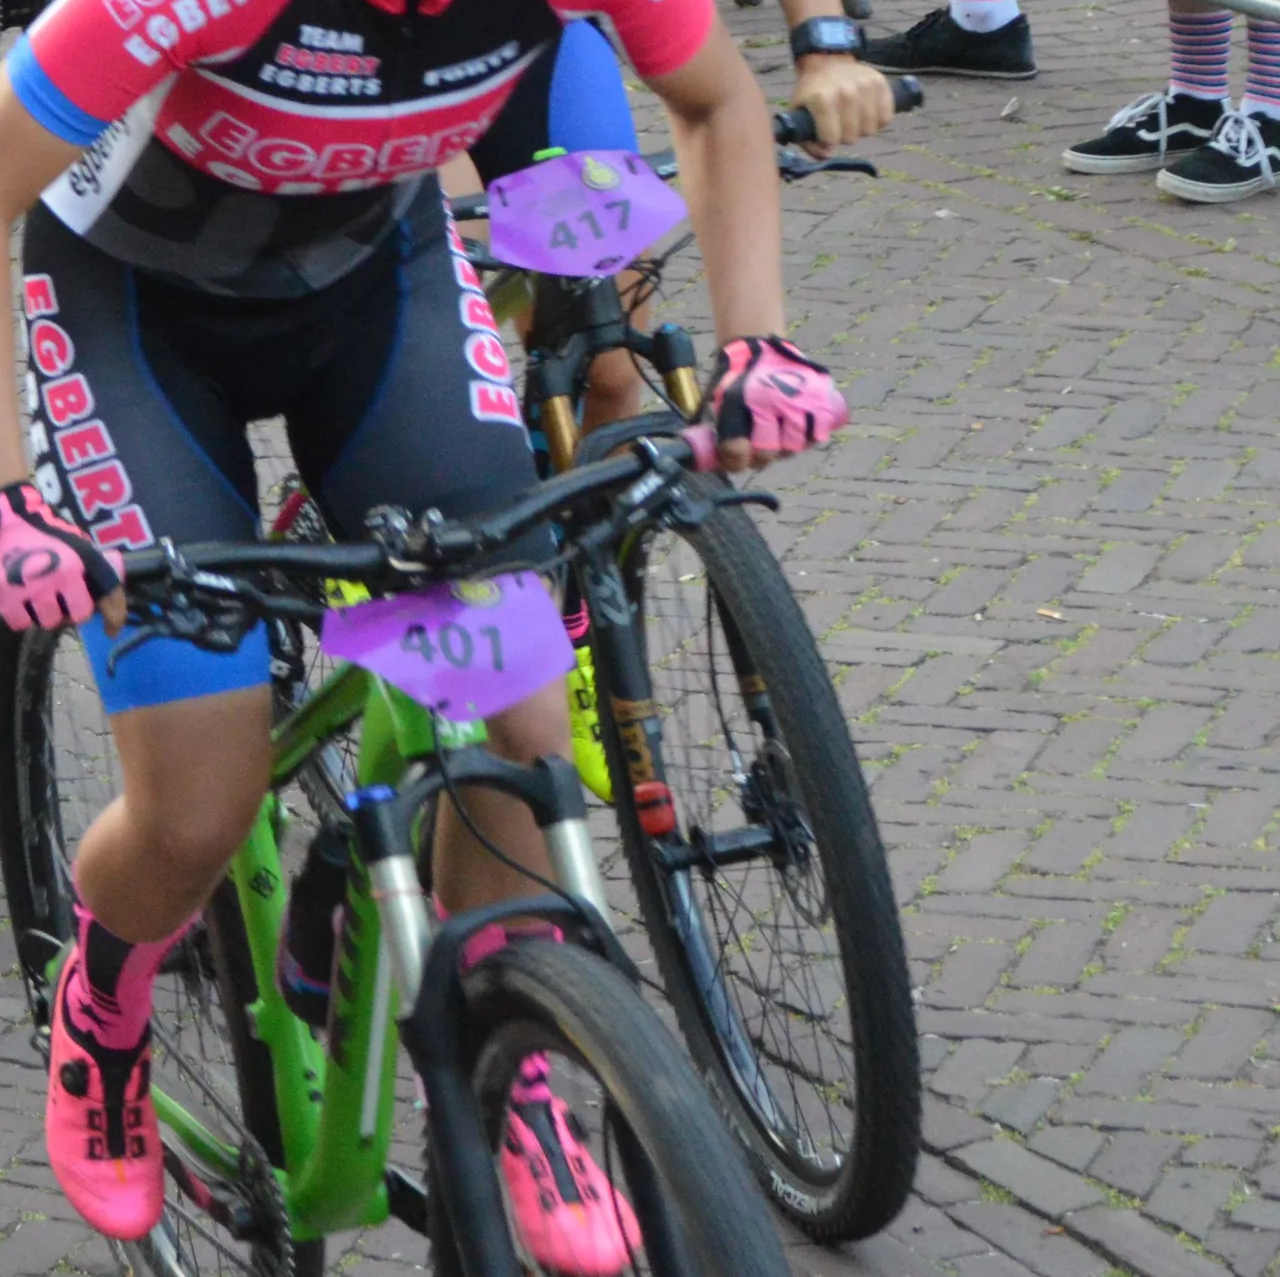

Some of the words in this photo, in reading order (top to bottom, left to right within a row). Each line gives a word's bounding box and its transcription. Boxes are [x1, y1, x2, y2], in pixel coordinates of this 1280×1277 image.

[275, 41, 382, 77] EGBERT
[299, 24, 365, 54] TEAM
[258, 62, 383, 97] EGBERTS
[549, 199, 632, 250] 417
[22, 272, 156, 552] EGBERT
[400, 623, 504, 672] 401
